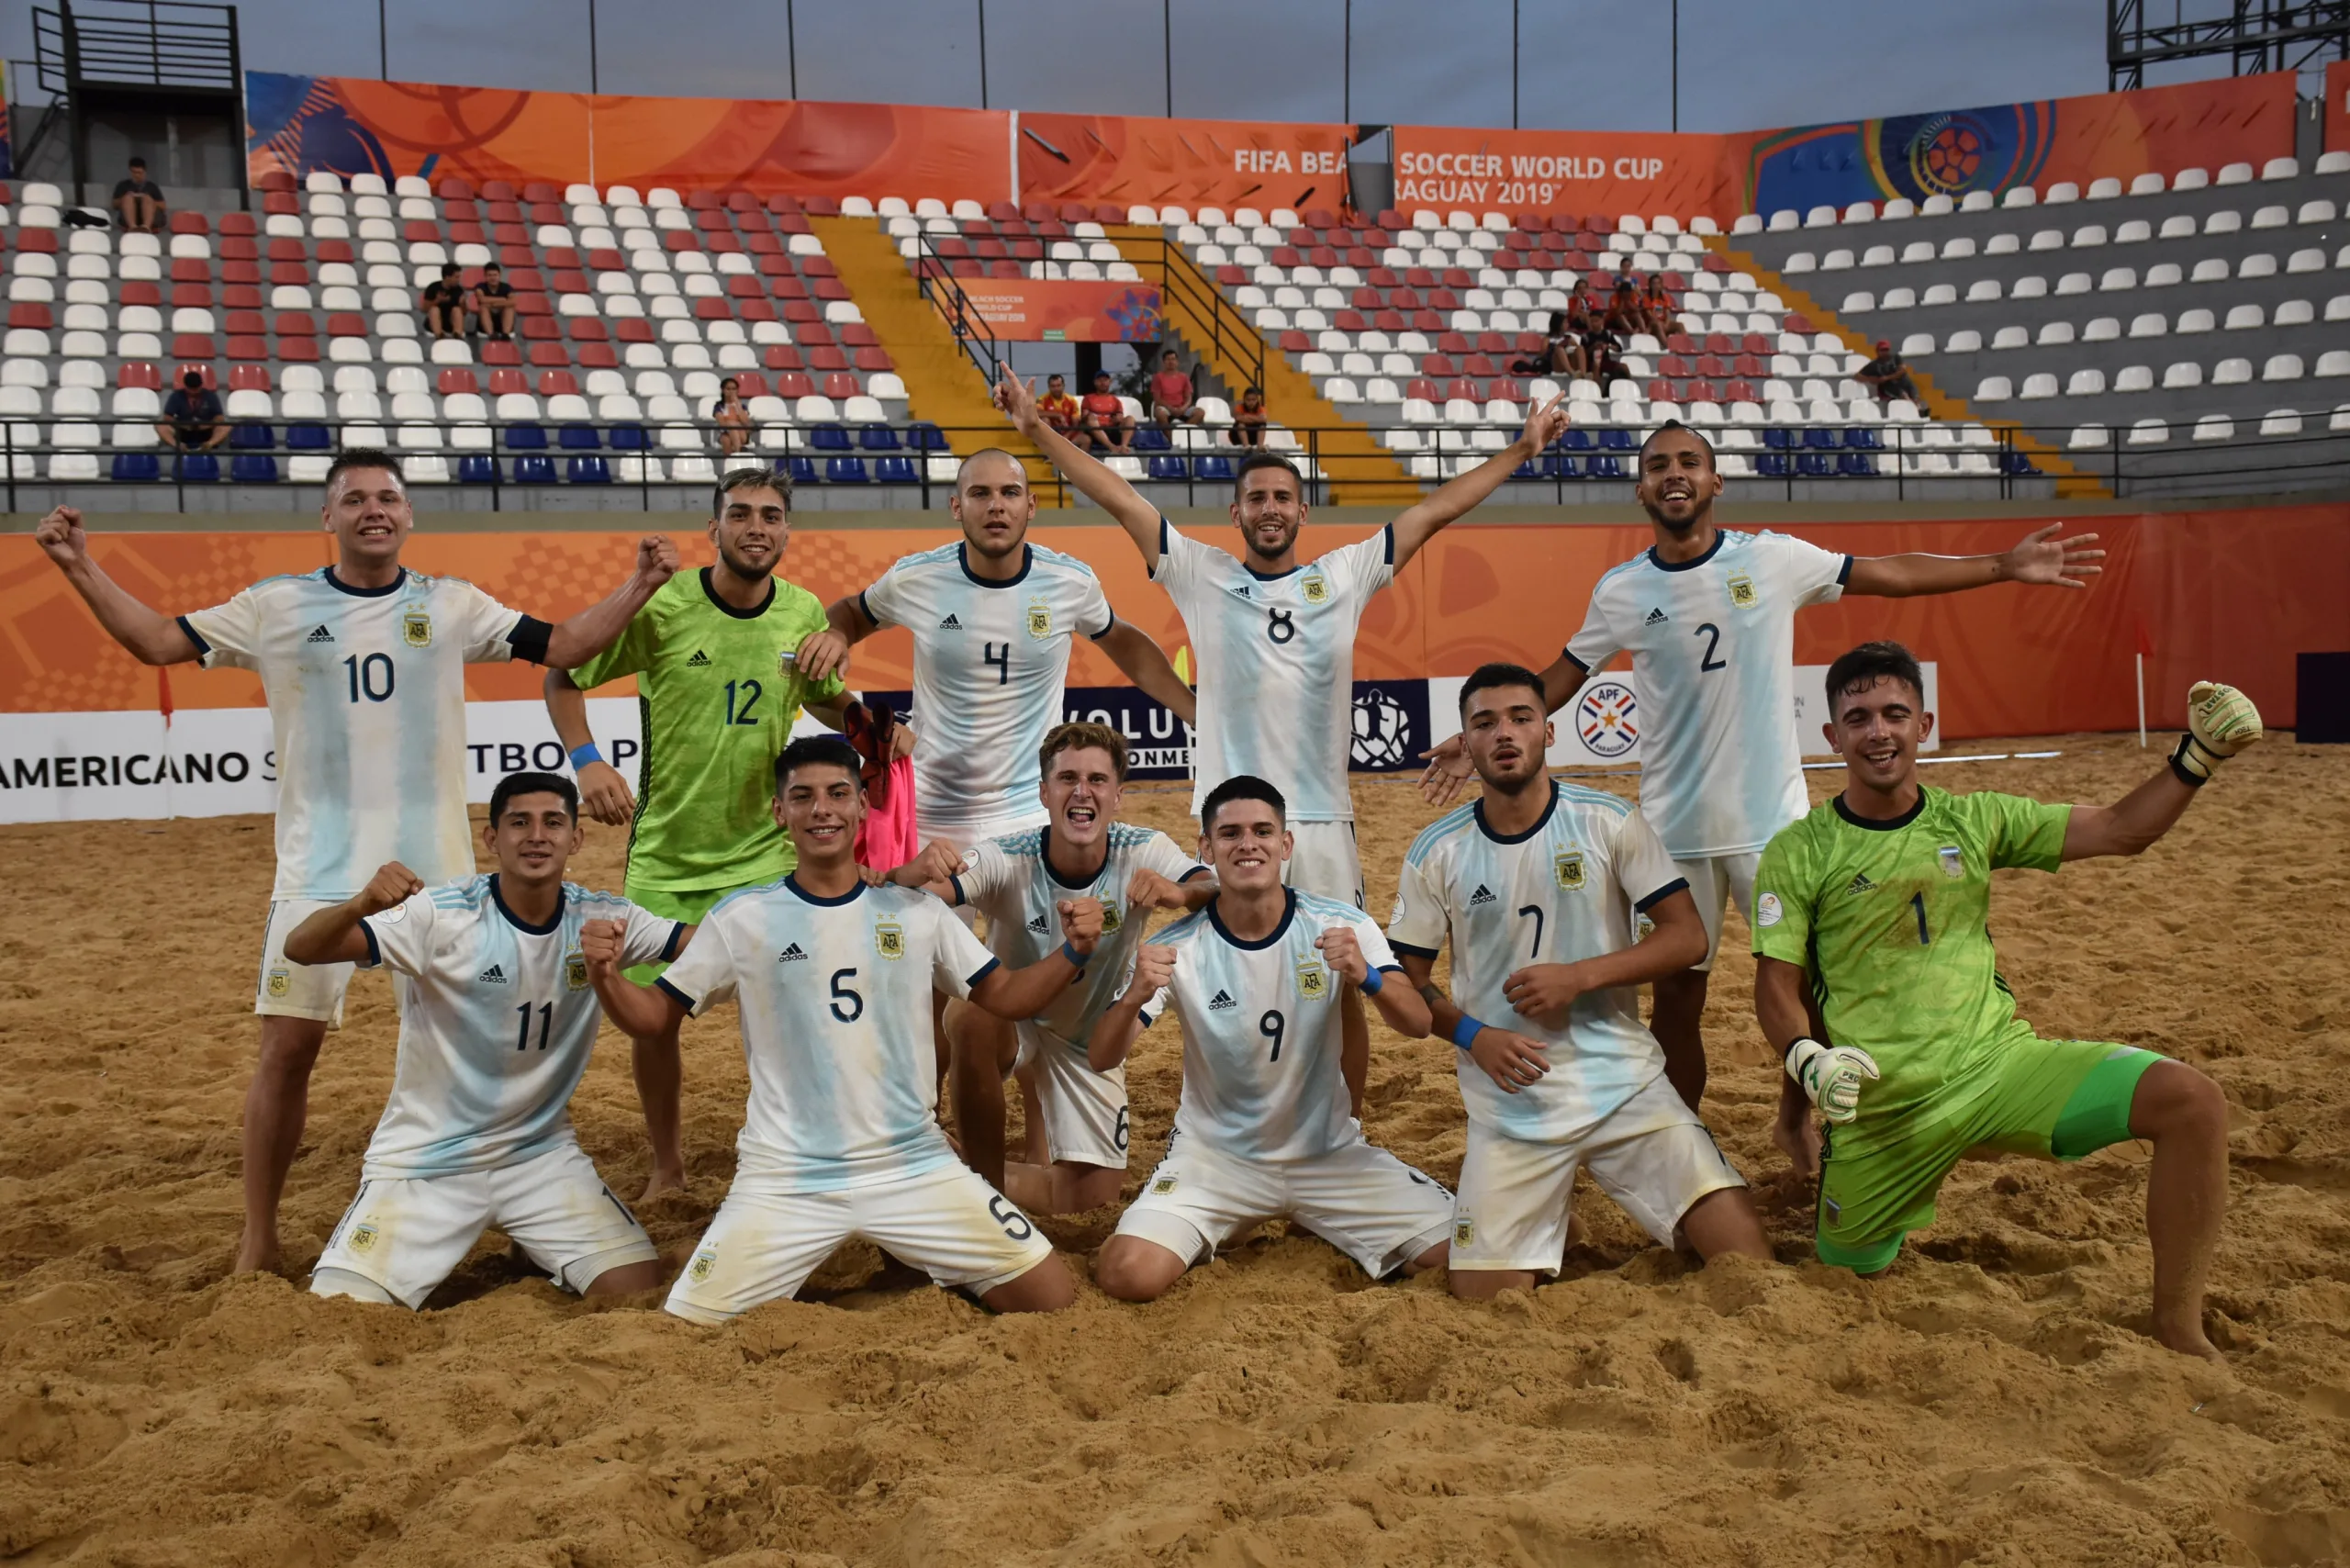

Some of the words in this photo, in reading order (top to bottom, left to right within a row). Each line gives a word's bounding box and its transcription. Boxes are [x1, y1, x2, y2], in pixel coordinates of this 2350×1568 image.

[1234, 150, 1292, 174] FIFA
[1400, 151, 1503, 177] SOCCER
[1510, 155, 1606, 179] WORLD
[1614, 157, 1663, 180] CUP
[1268, 607, 1294, 644] 8
[1645, 616, 1669, 626] adidas
[985, 642, 1009, 685] 4
[1694, 622, 1726, 672] 2
[342, 653, 395, 702] 10
[1598, 689, 1619, 700] APF
[723, 679, 762, 725] 12
[1470, 895, 1496, 905] adidas
[1847, 883, 1877, 896] adidas
[1027, 924, 1049, 935] adidas
[1518, 904, 1543, 958] 7
[1909, 890, 1930, 945] 1
[779, 953, 808, 962] adidas
[830, 968, 863, 1023] 5
[1209, 1000, 1237, 1010] adidas
[516, 1001, 552, 1050] 11
[1259, 1010, 1284, 1062] 9
[1114, 1105, 1129, 1150] 6
[989, 1194, 1031, 1240] 5
